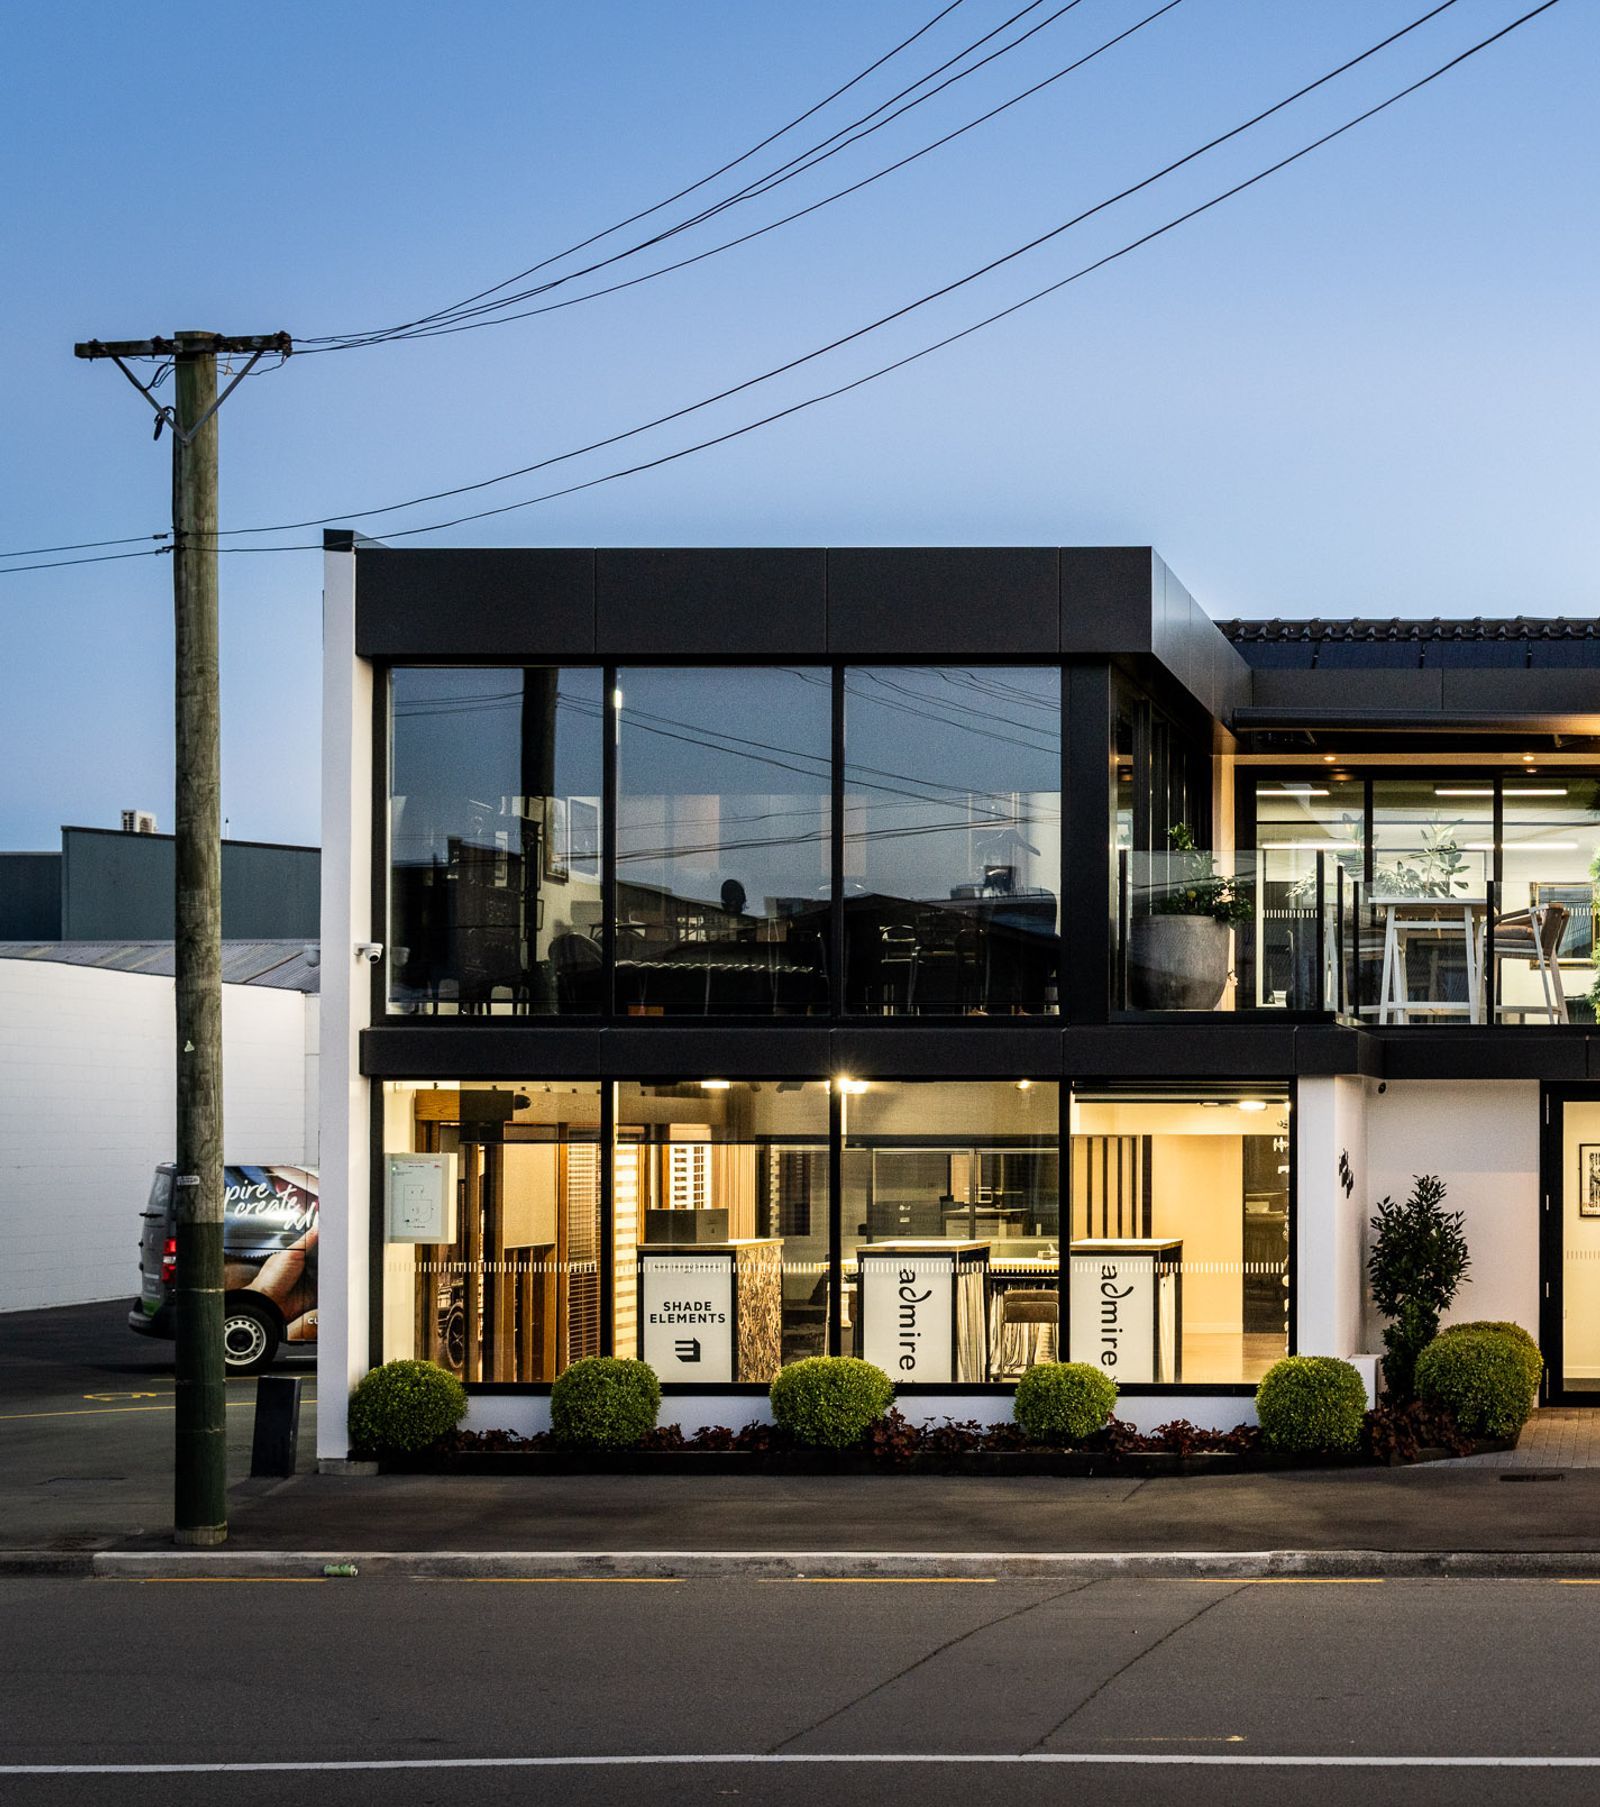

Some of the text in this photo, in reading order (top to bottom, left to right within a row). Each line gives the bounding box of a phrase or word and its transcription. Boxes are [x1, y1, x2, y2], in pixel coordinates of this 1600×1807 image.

[223, 1179, 270, 1212] pire
[234, 1184, 301, 1218] create
[649, 1313, 726, 1324] ELEMENTS
[663, 1301, 712, 1312] SHADE
[898, 1268, 933, 1371] admire
[1100, 1264, 1135, 1367] admire
